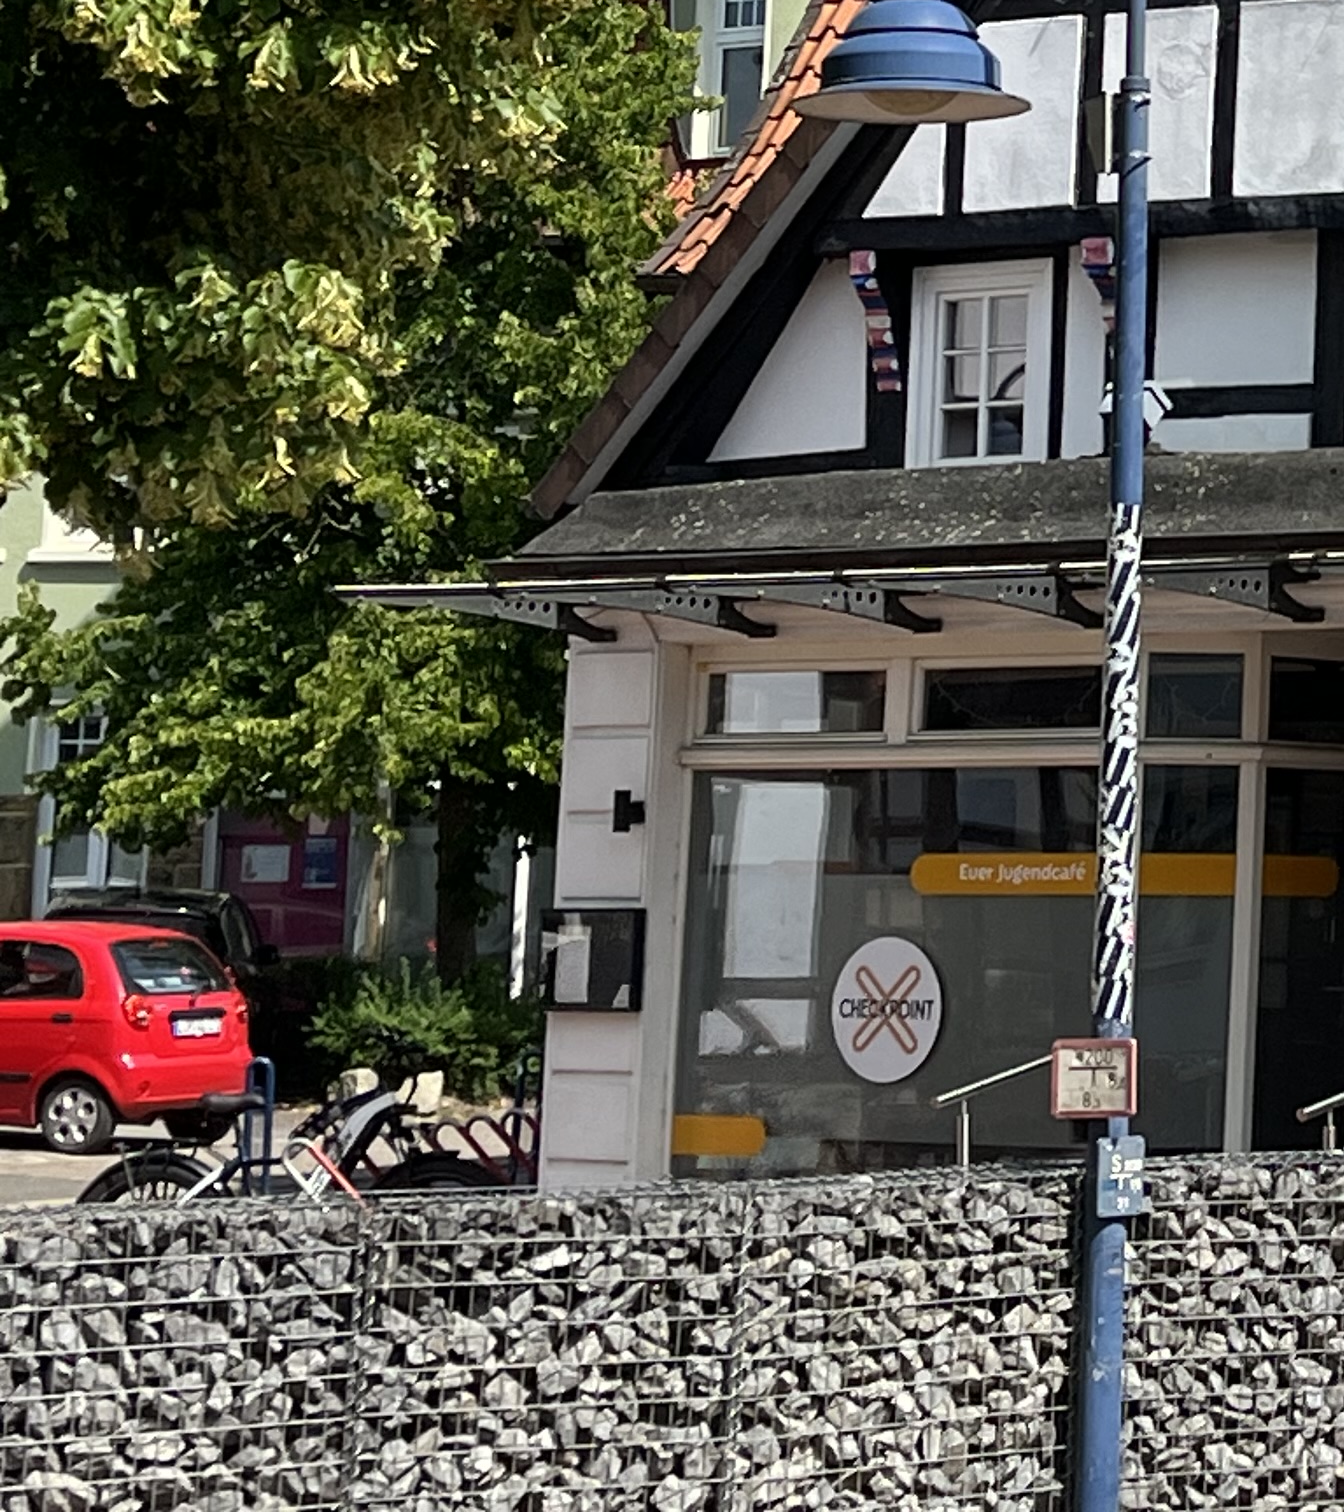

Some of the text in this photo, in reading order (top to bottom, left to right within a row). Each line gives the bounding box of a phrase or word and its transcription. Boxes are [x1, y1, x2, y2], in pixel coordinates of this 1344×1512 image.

[958, 861, 1086, 885] Euer Jugendcafé
[839, 998, 934, 1021] CHECKPOINT
